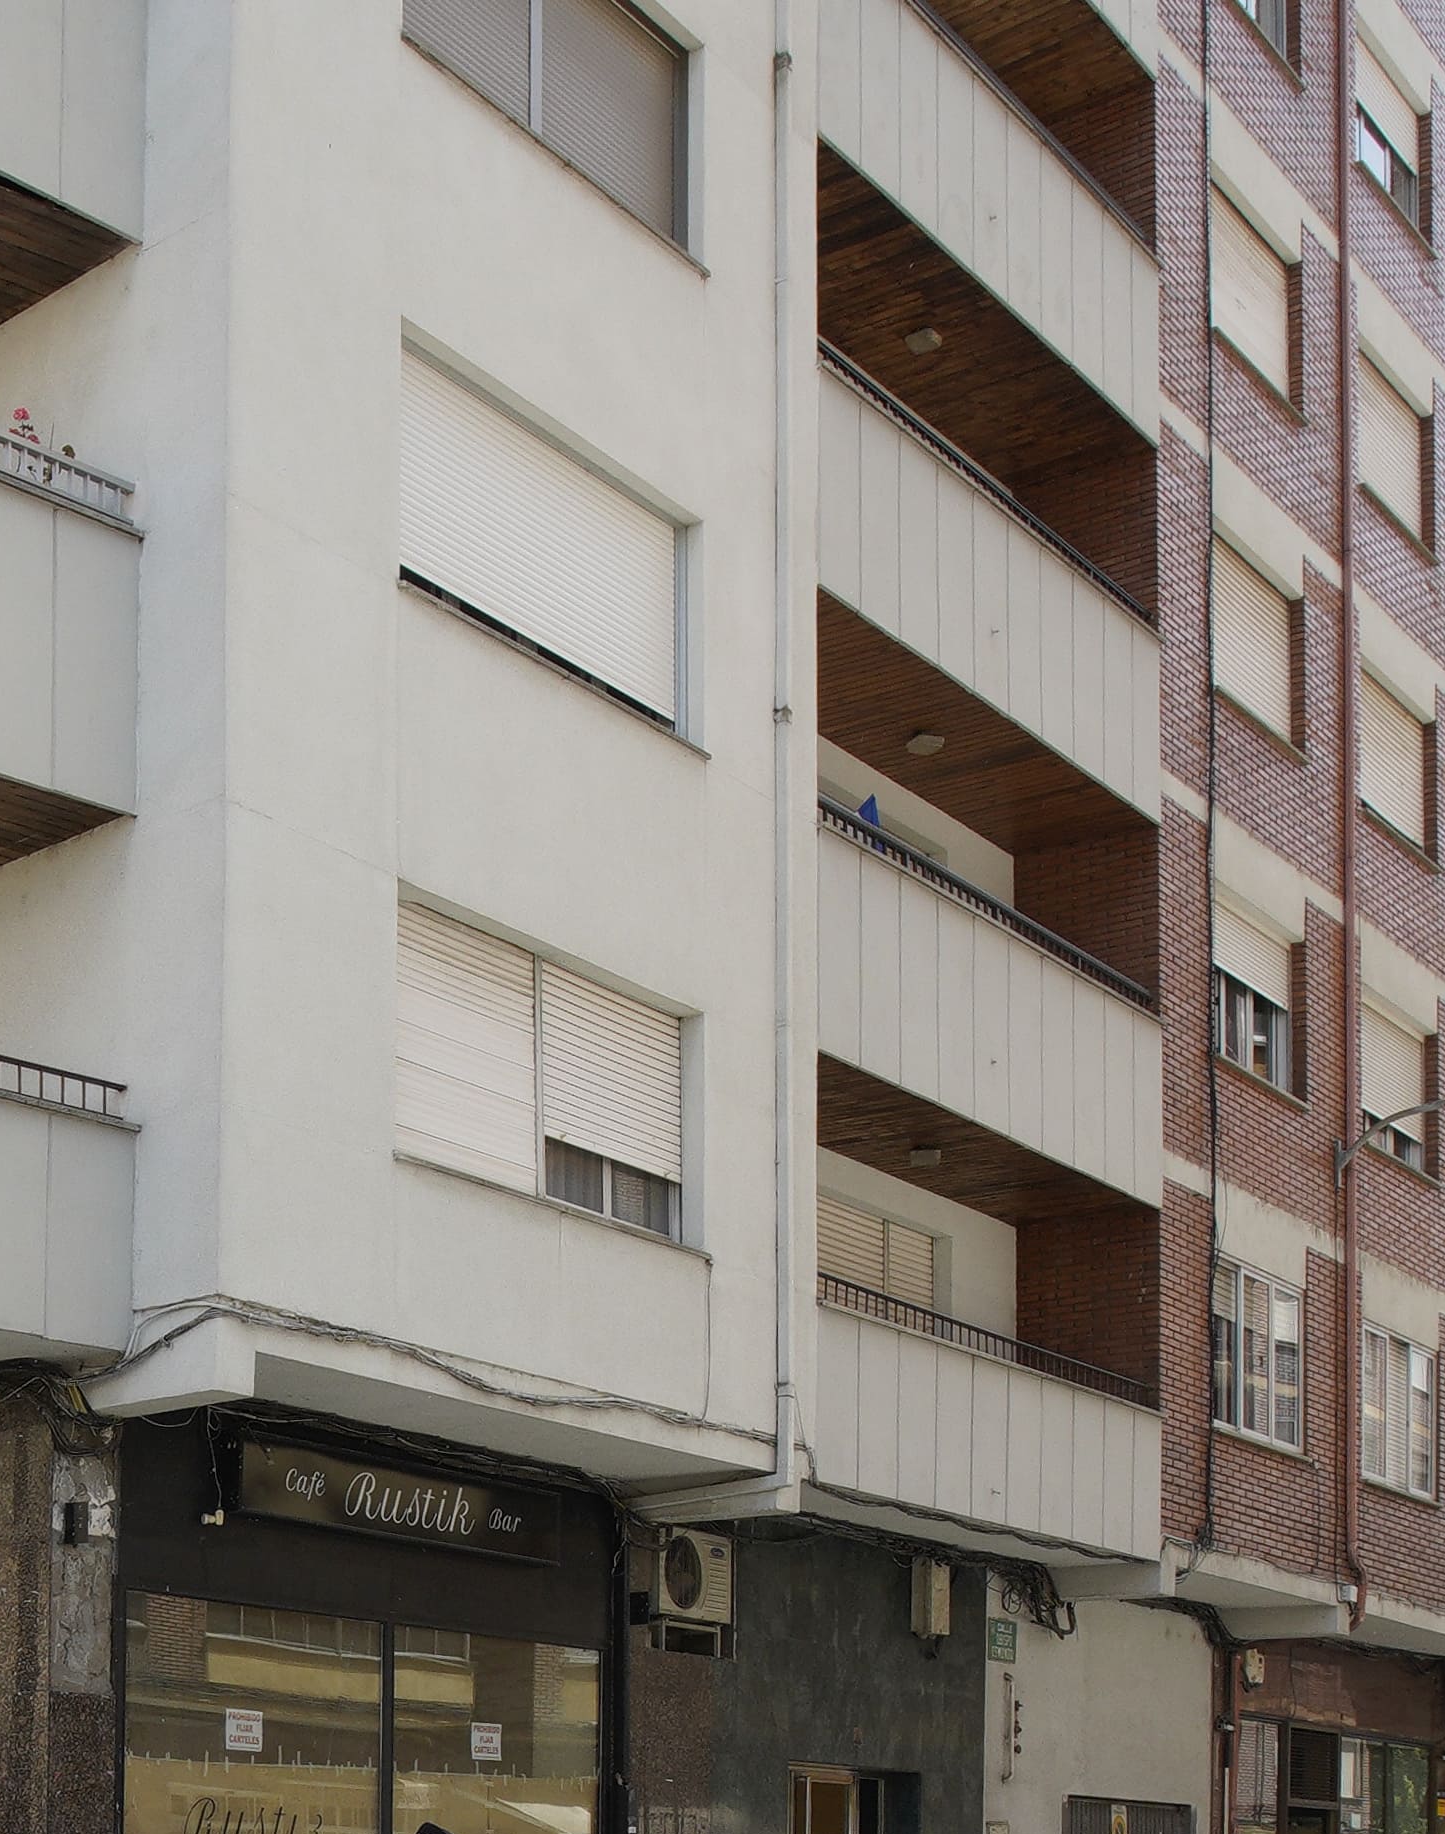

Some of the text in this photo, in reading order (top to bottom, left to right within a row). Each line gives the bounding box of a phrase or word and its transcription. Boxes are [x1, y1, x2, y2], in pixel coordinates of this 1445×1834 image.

[285, 1467, 522, 1535] Café Rustik Bar
[228, 1711, 261, 1722] PROHIBIDO
[236, 1723, 254, 1734] FIJAR
[229, 1734, 260, 1745] CARTELES
